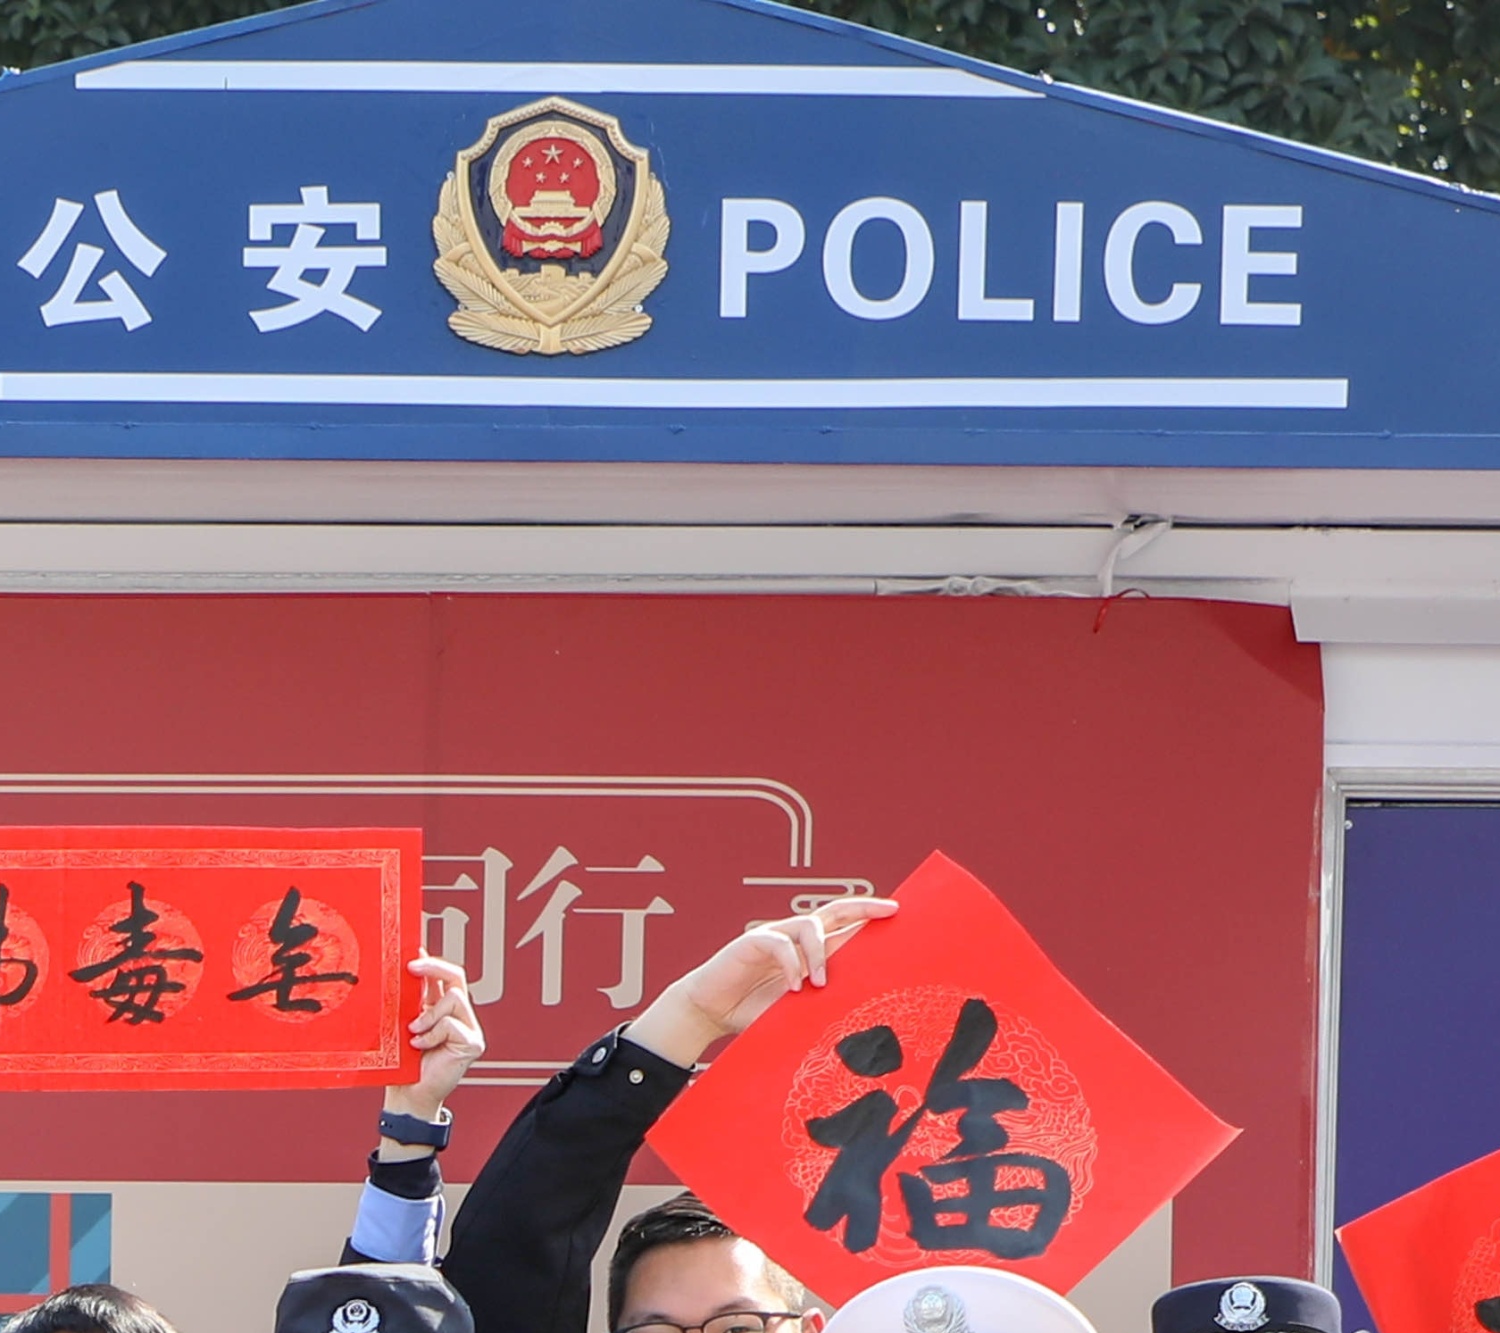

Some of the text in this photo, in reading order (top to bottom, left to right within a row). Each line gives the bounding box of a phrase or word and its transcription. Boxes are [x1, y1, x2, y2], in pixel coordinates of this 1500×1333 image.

[18, 189, 387, 332] 公安
[721, 197, 1303, 326] POLICE
[805, 998, 1071, 1260] 福
